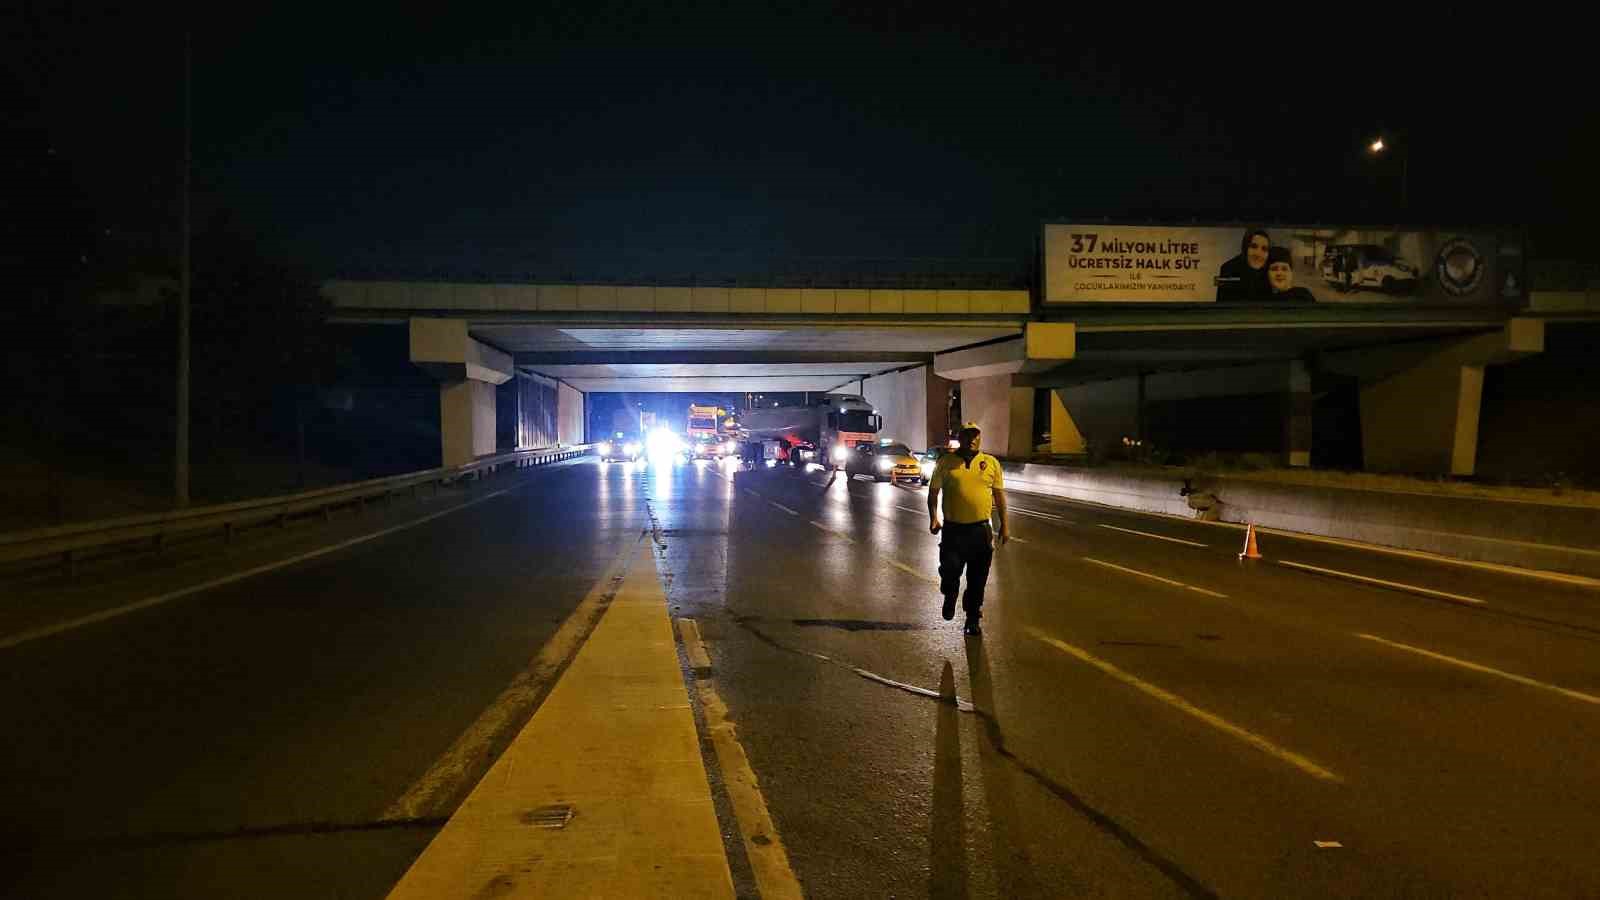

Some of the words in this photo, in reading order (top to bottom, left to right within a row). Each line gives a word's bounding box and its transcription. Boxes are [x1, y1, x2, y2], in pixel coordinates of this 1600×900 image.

[1071, 234, 1098, 253] 37
[1101, 239, 1156, 254] MİLYON
[1159, 240, 1199, 254] LİTRE
[1068, 255, 1133, 269] ÜCRETSİZ
[1136, 258, 1171, 270] HALK
[1175, 256, 1201, 270] SÜT
